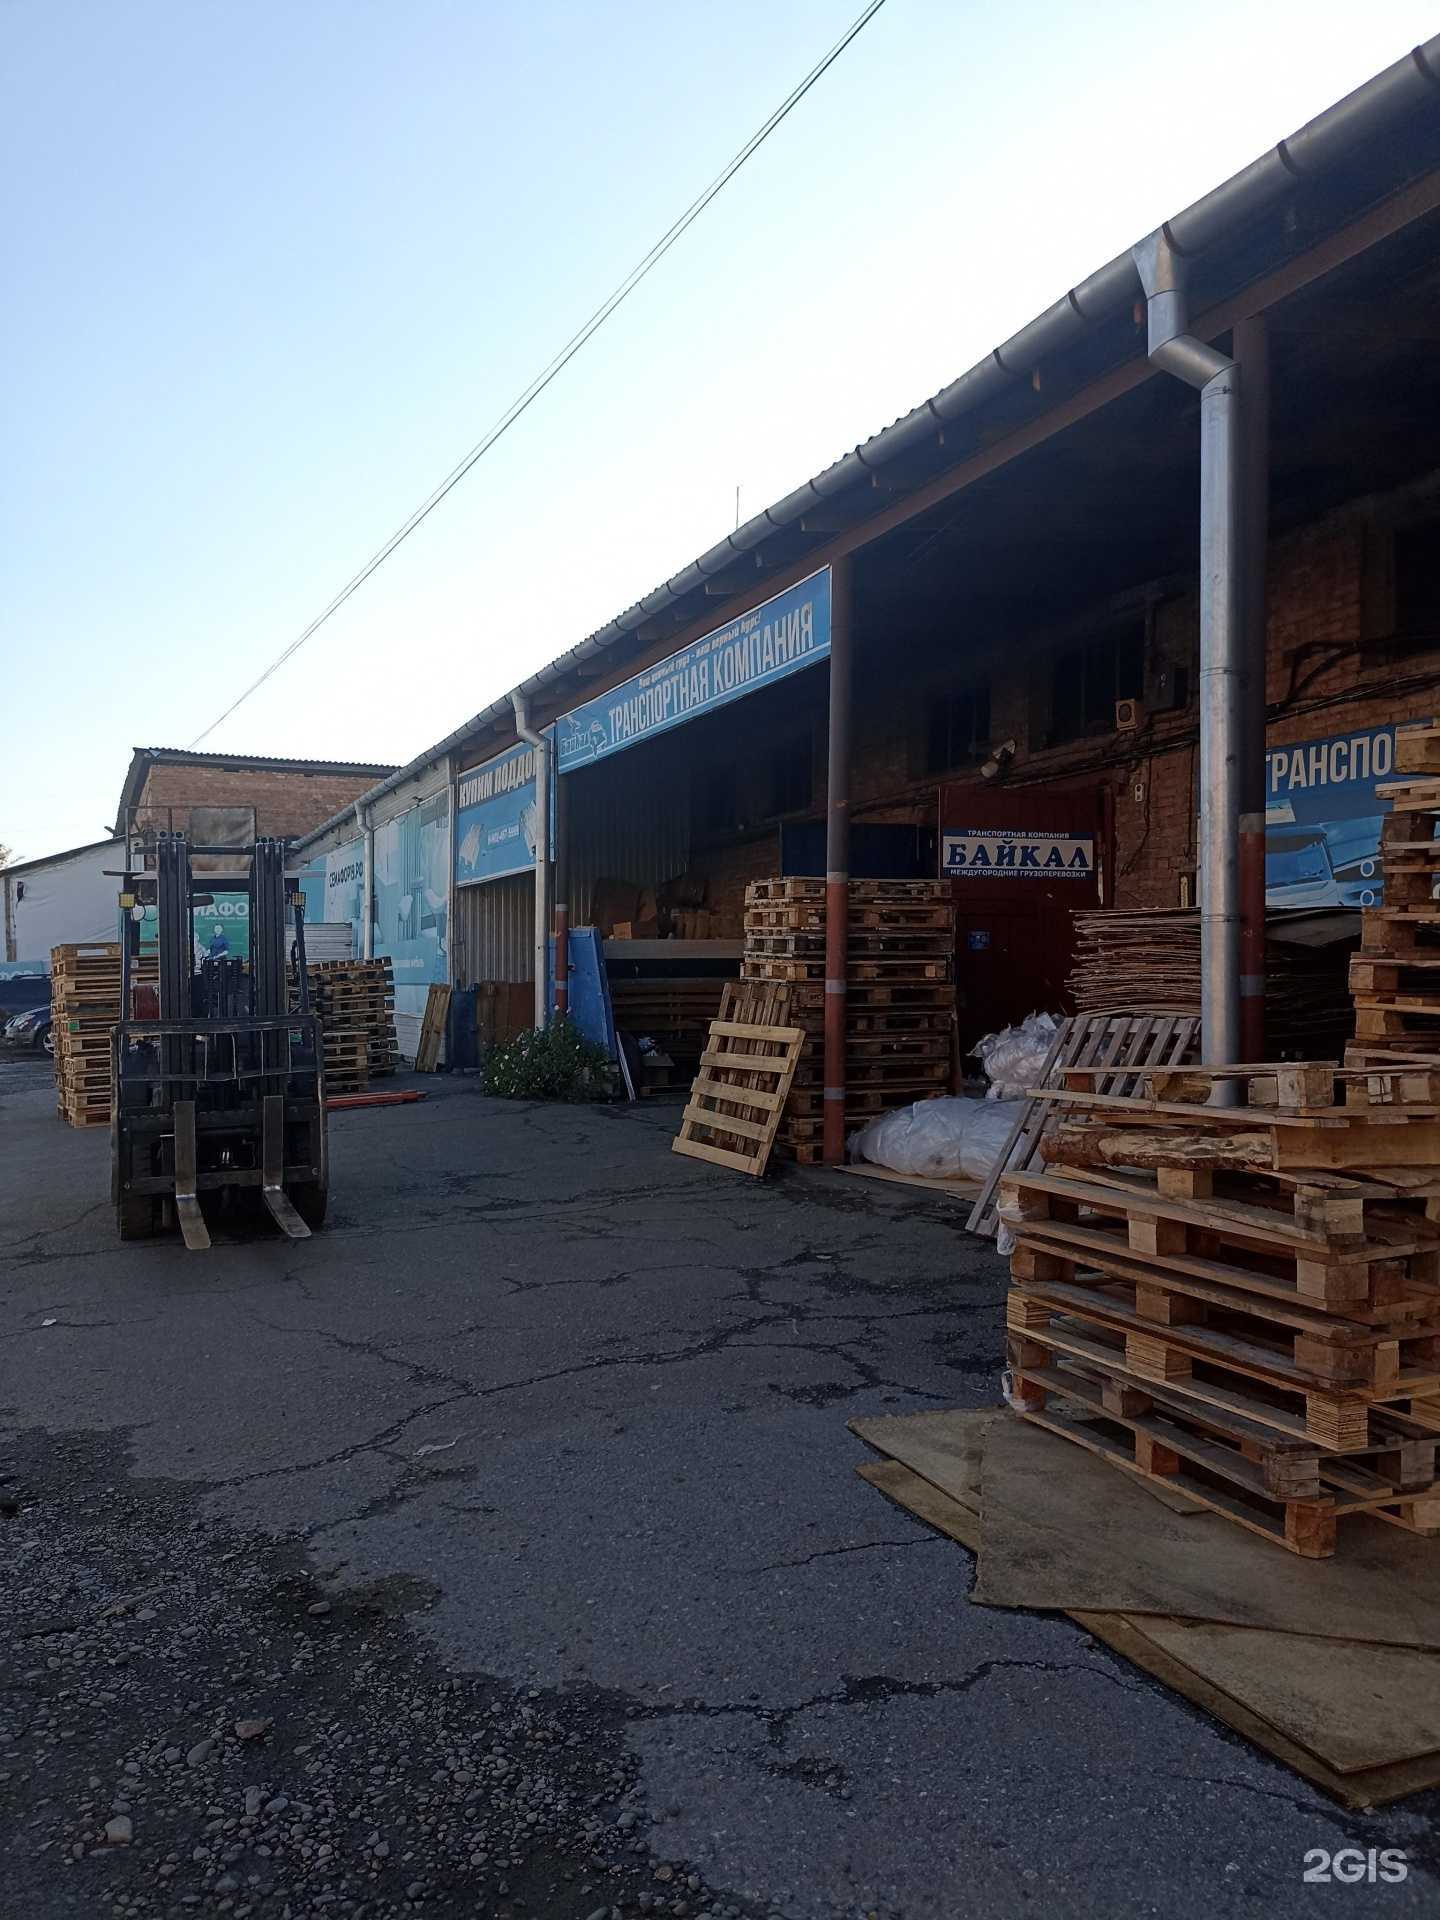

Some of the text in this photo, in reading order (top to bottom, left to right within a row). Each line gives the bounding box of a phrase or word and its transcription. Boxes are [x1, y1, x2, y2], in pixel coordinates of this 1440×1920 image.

[608, 600, 814, 744] ТРАНСПОРТНАЯ КОМПАНИЯ
[1266, 733, 1392, 793] РАНСПО
[459, 771, 493, 808] КУПИМ
[967, 830, 1070, 839] ТРАНСПОРТНАЯ КОМПАНИЯ
[946, 839, 1090, 868] БАЙКАЛ
[950, 868, 1086, 878] МЕЖДУГОРОДНИЕ ГРУЗОПЕРЕВОЗКИ
